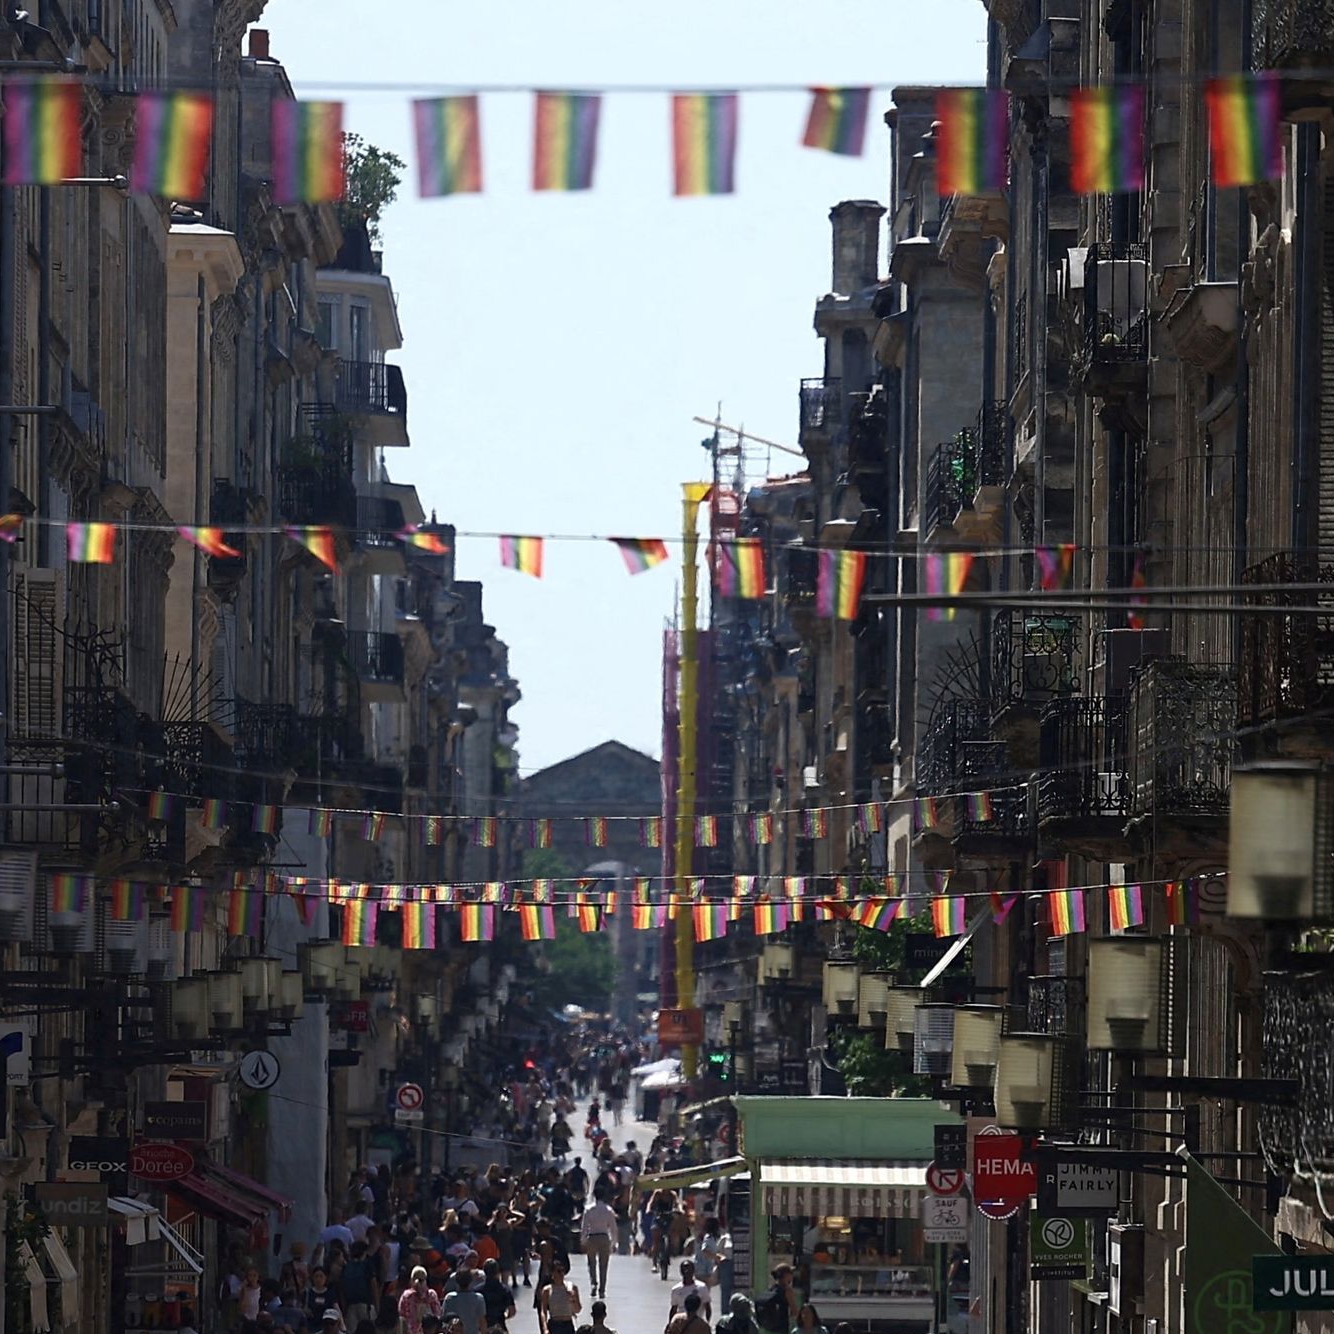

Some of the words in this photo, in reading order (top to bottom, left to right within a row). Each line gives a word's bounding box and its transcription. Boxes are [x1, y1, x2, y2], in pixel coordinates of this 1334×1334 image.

[70, 1160, 127, 1173] GEOX
[132, 1156, 185, 1174] Dorée
[976, 1158, 1034, 1175] HEMA
[1060, 1180, 1115, 1190] FAIRLY
[935, 1199, 957, 1207] SAUF
